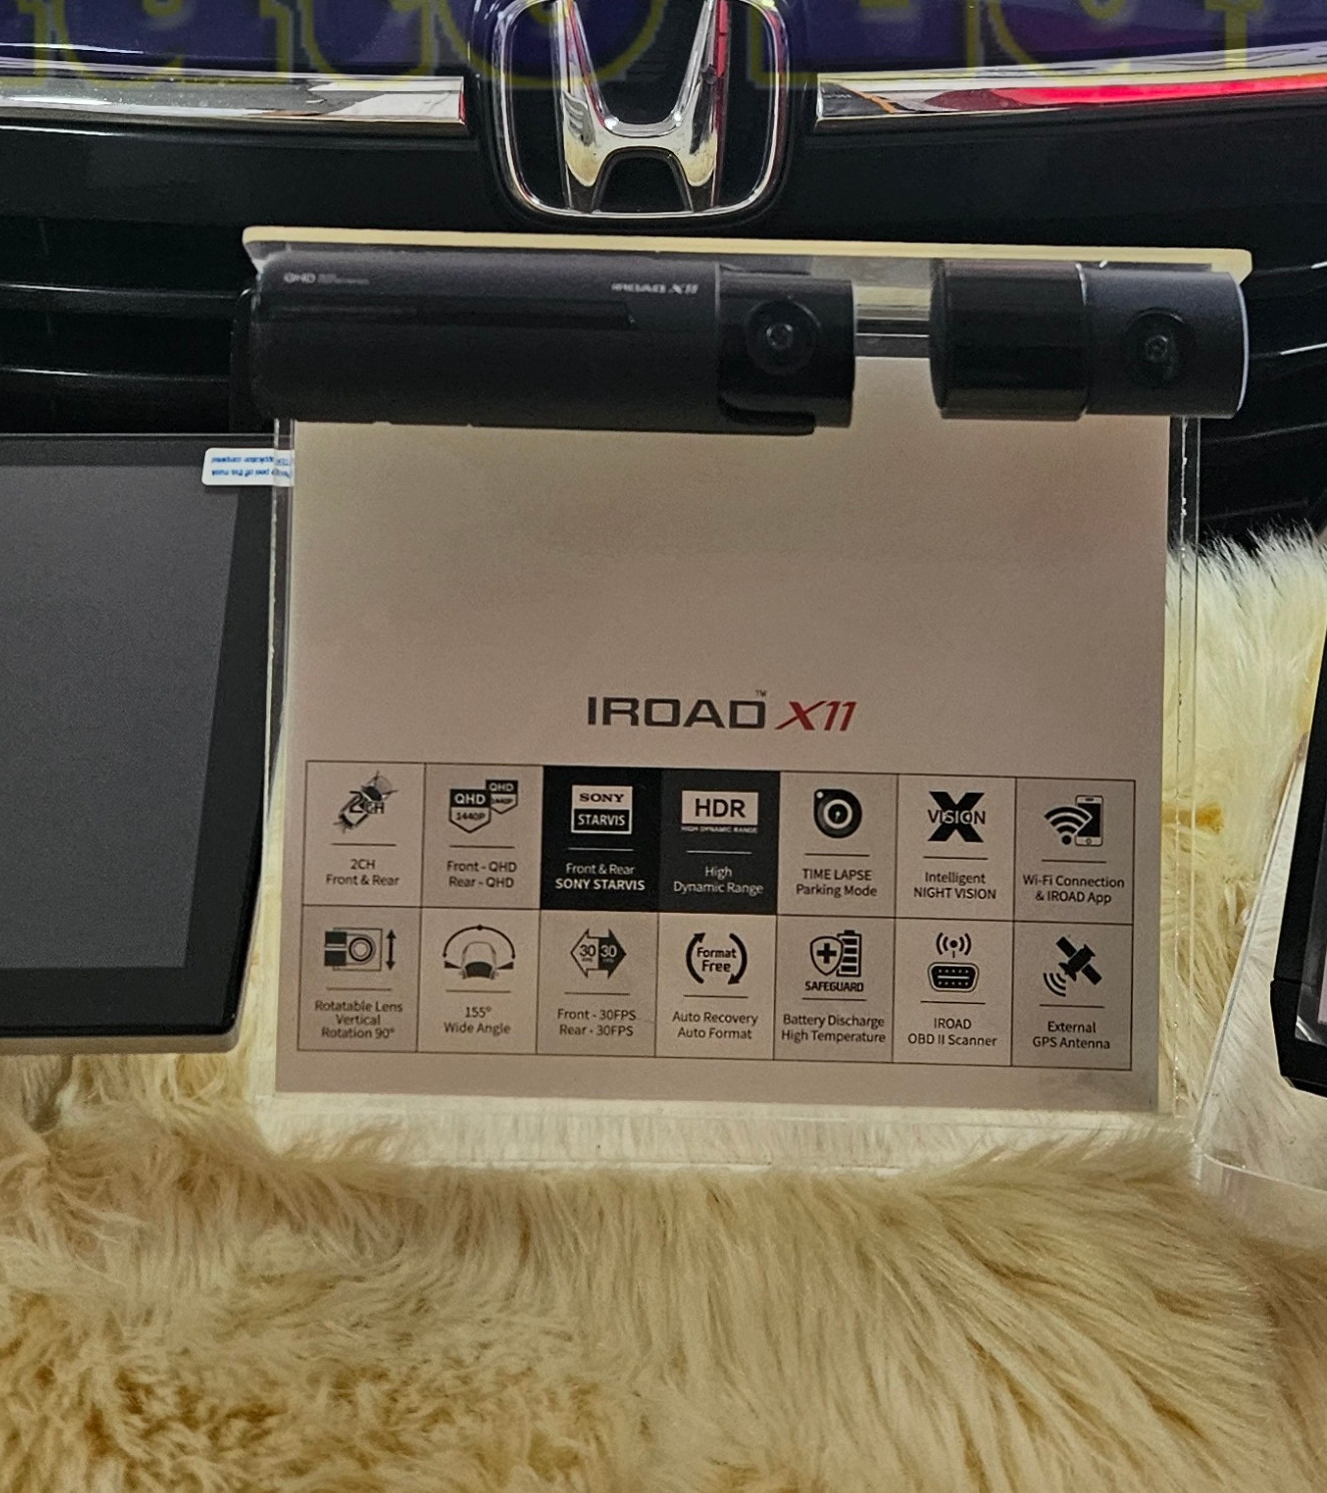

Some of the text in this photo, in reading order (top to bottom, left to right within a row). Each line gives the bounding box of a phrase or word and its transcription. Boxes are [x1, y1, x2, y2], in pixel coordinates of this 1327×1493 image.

[587, 696, 766, 729] IROAD
[775, 700, 857, 731] X11
[454, 794, 486, 805] QHD
[579, 793, 624, 803] SONY
[695, 798, 745, 818] HDR
[456, 812, 485, 821] 1440P
[578, 813, 625, 826] STARVIS
[927, 809, 986, 825] VISION
[350, 859, 376, 870] 2CH
[447, 860, 480, 872] Front
[488, 861, 517, 873] QHD
[566, 863, 634, 875] Front & Rear
[705, 866, 732, 879] High
[802, 868, 872, 882] TIME LAPSE
[925, 872, 986, 886] Intelligent
[326, 874, 400, 887] Front & Rear
[448, 875, 476, 888] Rear
[485, 876, 514, 889] QHD
[555, 878, 645, 892] SONY STARVIS
[1023, 875, 1124, 889] Wi-Fi Connection
[673, 880, 764, 896] Dynamic Range
[796, 884, 878, 898] Parking Mode
[913, 887, 997, 901] NIGHT VISION
[1035, 891, 1112, 906] & IROAD App
[580, 944, 596, 957] 30
[601, 945, 617, 957] 30
[697, 946, 737, 959] Format
[702, 960, 731, 973] Free
[805, 981, 864, 992] SAFEGUARD
[315, 1001, 403, 1012] Rotatable Lens
[465, 1006, 492, 1018] 155°
[336, 1014, 380, 1026] Vertical
[557, 1009, 590, 1020] Front
[601, 1010, 636, 1021] 30FPS
[672, 1011, 758, 1026] Auto Recovery
[784, 1014, 885, 1029] Battery Discharge
[444, 1022, 511, 1036] Wide Angle
[934, 1018, 972, 1030] IROAD
[1047, 1021, 1096, 1034] External
[321, 1027, 395, 1039] Rotation 90°
[559, 1025, 587, 1036] Rear
[597, 1026, 634, 1037] 30FPS
[677, 1027, 752, 1039] Auto Format
[781, 1029, 886, 1045] High Temperature
[908, 1033, 934, 1046] OBD
[947, 1034, 998, 1047] Scanner
[1032, 1037, 1111, 1051] GPS Antenna
